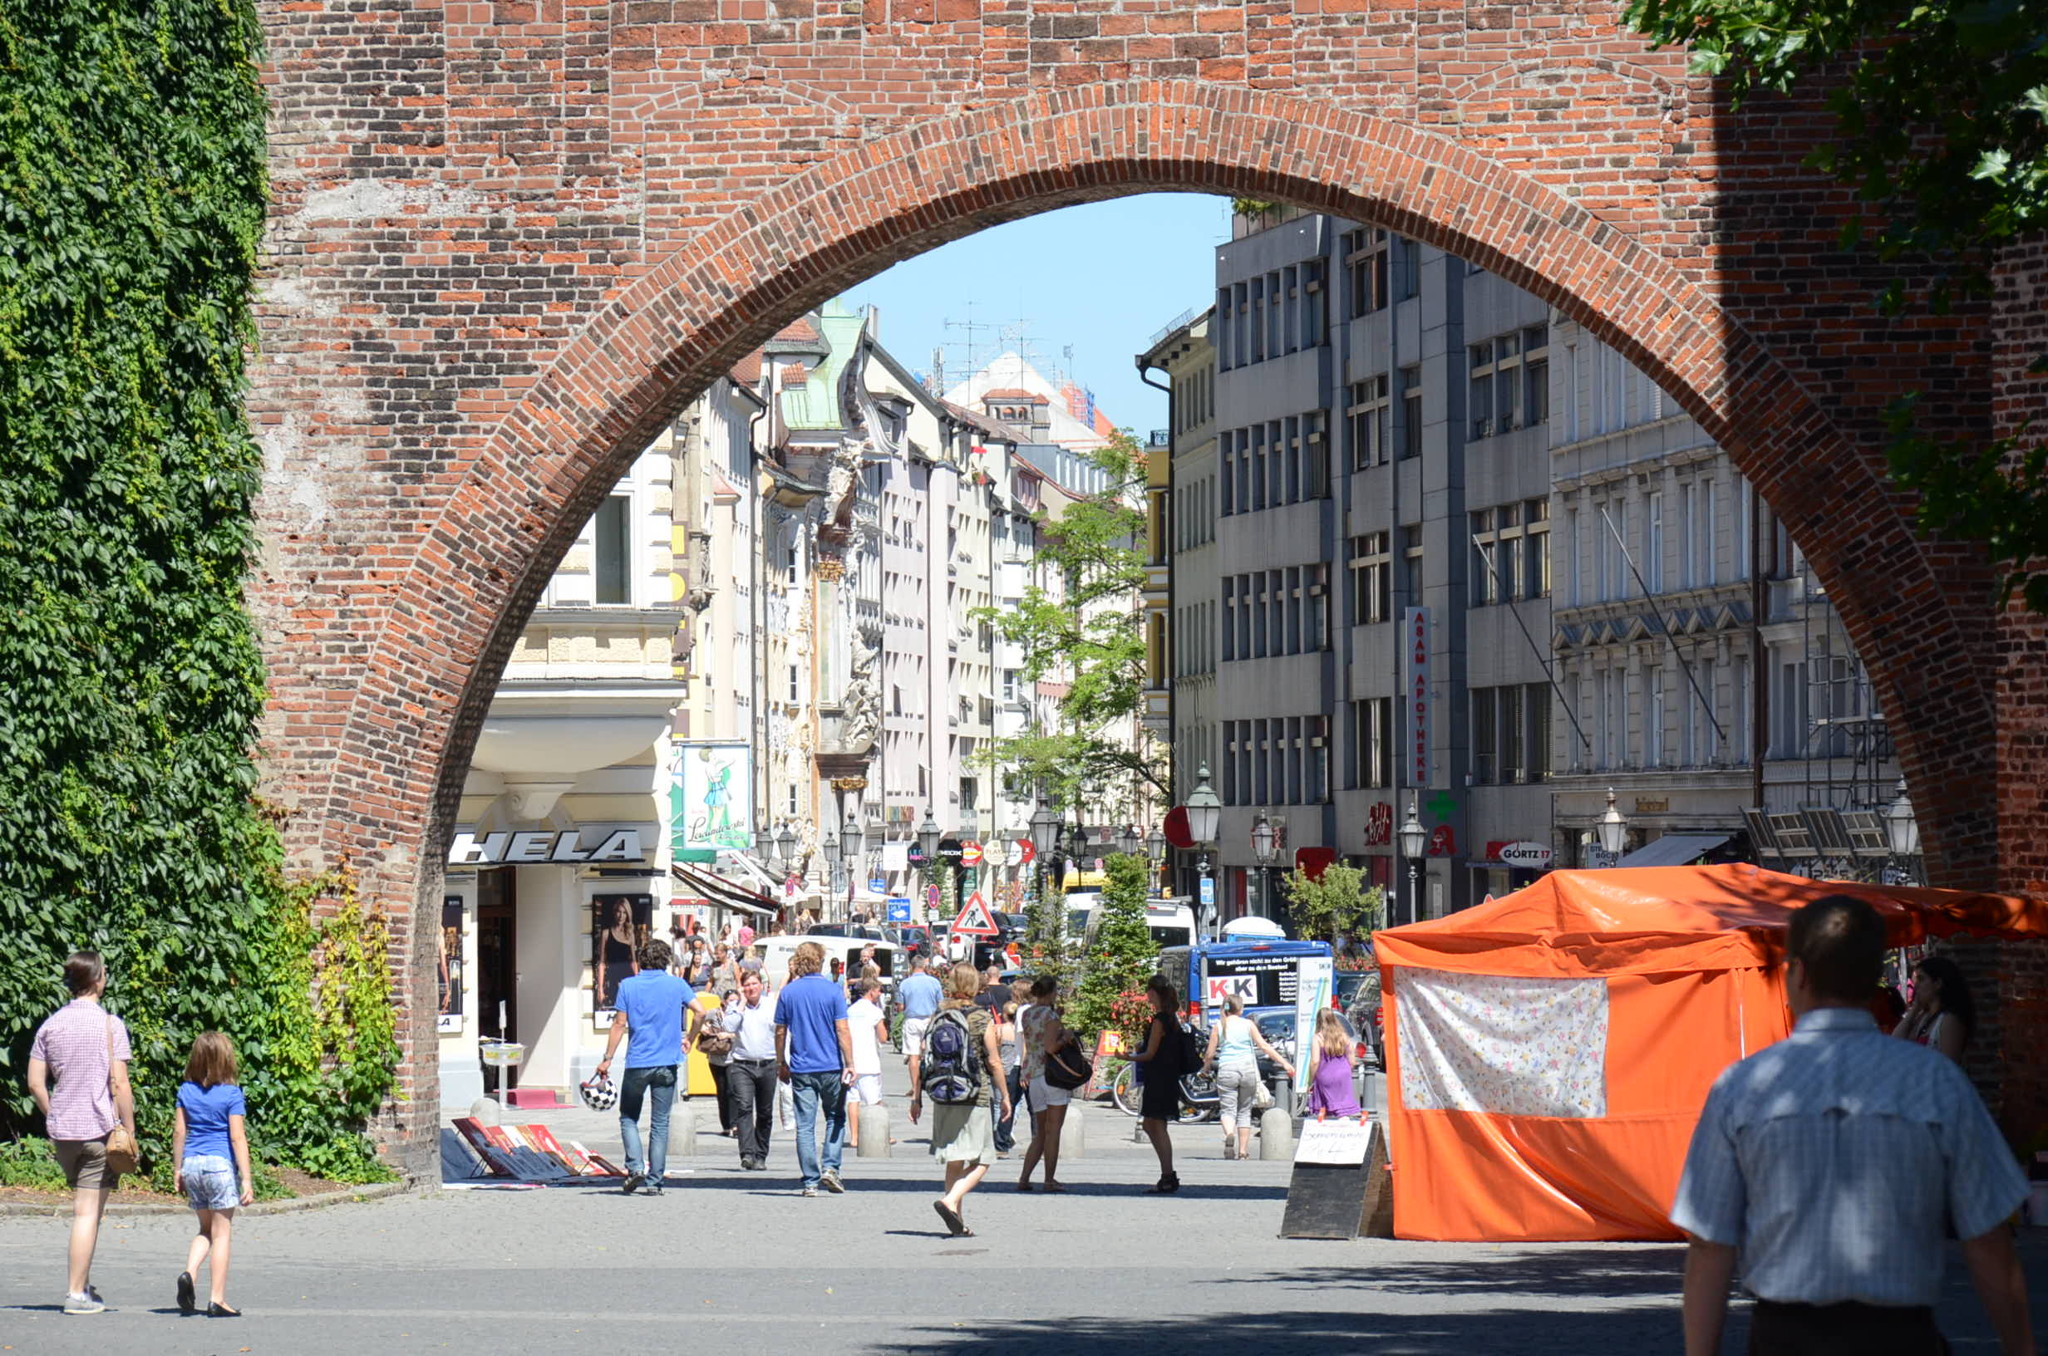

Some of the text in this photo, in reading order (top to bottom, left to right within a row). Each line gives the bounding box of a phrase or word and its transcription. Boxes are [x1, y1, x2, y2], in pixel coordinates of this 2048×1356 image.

[1414, 611, 1426, 782] ASAM APOTHEKE
[449, 830, 642, 863] HELA
[1540, 850, 1550, 859] 17
